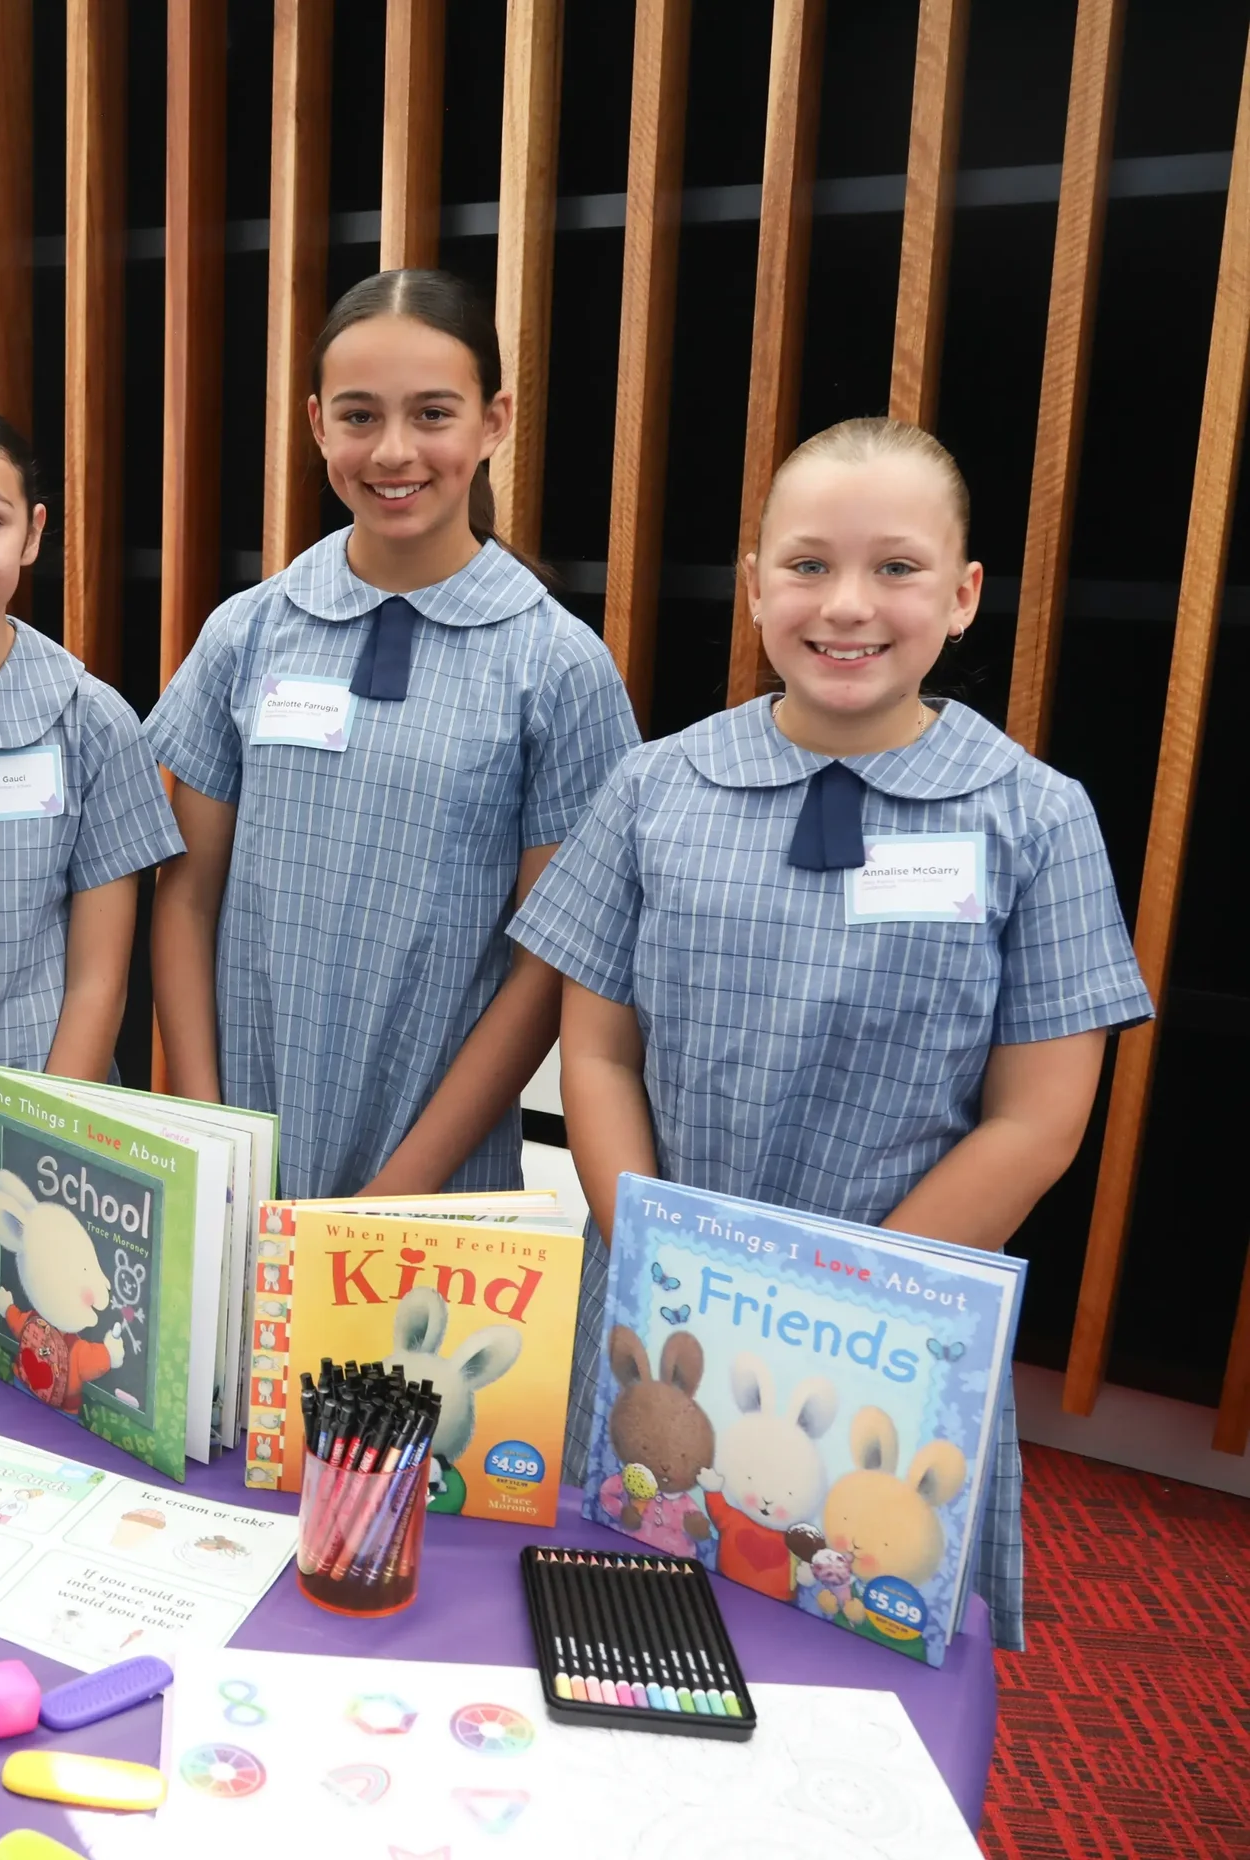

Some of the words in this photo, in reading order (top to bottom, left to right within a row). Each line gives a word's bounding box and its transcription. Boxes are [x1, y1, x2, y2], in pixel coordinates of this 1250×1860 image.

[267, 700, 302, 708] Charlotte
[304, 702, 339, 713] Farrugia
[2, 774, 26, 783] Gauci
[862, 867, 909, 877] Annalise
[912, 866, 960, 876] McGarry
[19, 1097, 65, 1129] Things
[73, 1119, 80, 1134] I
[87, 1124, 122, 1150] Love
[129, 1141, 176, 1173] About
[37, 1155, 151, 1239] School
[86, 1221, 110, 1239] Trace
[113, 1232, 150, 1259] Moroney
[325, 1223, 386, 1242] When
[455, 1237, 548, 1262] Feeling
[641, 1199, 683, 1226] The
[695, 1214, 775, 1253] Things
[789, 1243, 799, 1259] I
[814, 1249, 872, 1282] Love
[885, 1272, 969, 1312] About
[324, 1247, 544, 1325] Kind
[698, 1266, 920, 1384] Friends
[17, 1472, 72, 1493] Cards
[491, 1454, 539, 1477] $4.99
[141, 1491, 163, 1502] Ice
[165, 1499, 210, 1515] cream
[213, 1511, 230, 1519] or
[233, 1516, 275, 1530] cake?
[488, 1498, 539, 1517] Moroney
[499, 1493, 533, 1506] Trace
[66, 1577, 97, 1592] into
[153, 1604, 193, 1621] what
[82, 1568, 99, 1580] If
[98, 1575, 127, 1588] you
[131, 1585, 174, 1602] could
[175, 1598, 196, 1608] go
[868, 1588, 923, 1624] $5.99
[57, 1589, 106, 1609] would
[107, 1605, 136, 1619] you
[141, 1614, 184, 1630] take?
